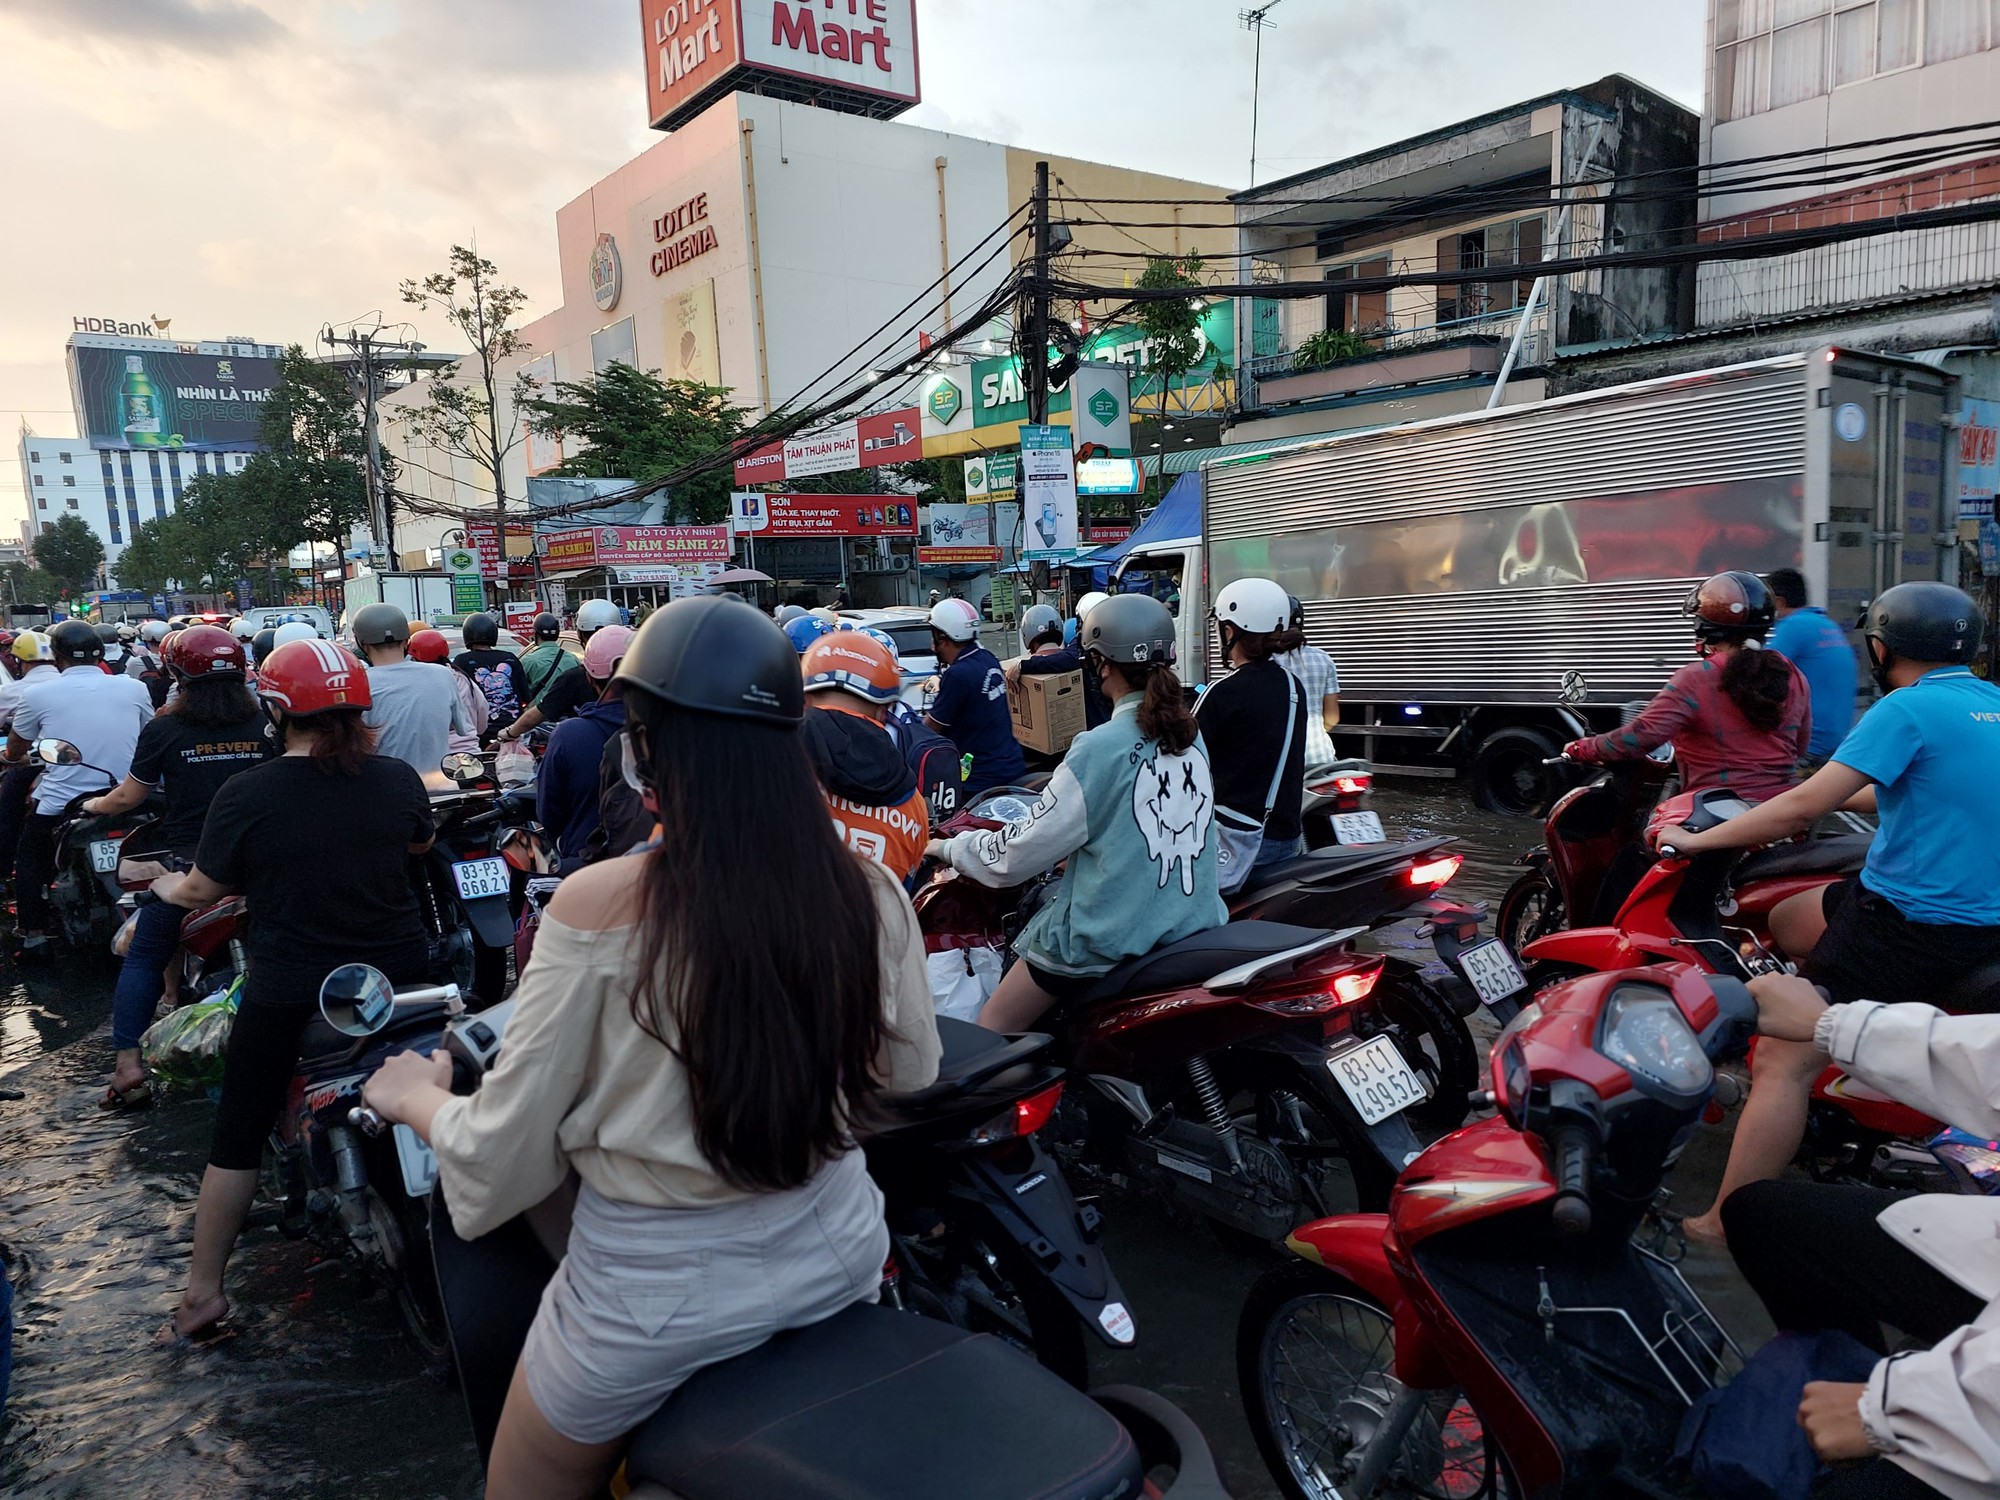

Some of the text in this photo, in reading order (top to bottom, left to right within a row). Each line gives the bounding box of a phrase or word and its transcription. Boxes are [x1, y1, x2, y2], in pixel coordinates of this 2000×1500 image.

[772, 1, 891, 71] Mart
[659, 8, 722, 92] Mart
[653, 192, 708, 243] LOTTE
[650, 225, 718, 277] CINEMA
[73, 316, 154, 336] HDBank
[176, 385, 218, 400] NHÌN
[220, 386, 240, 401] LÀ
[935, 391, 953, 405] SP
[1095, 400, 1114, 411] SP
[786, 437, 856, 459] TÂM THUẬN PHÁT
[746, 453, 783, 468] ARISTON
[770, 497, 791, 507] SƠN
[772, 508, 787, 516] RỬA
[773, 518, 787, 527] HÚT
[635, 527, 716, 537] BÒ TƠ TÂY NINH
[585, 541, 593, 552] 27
[626, 537, 727, 552] NĂM SÁNH 27
[195, 741, 260, 755] PR-EVENT
[187, 753, 236, 763] POLYTECHNIC
[931, 781, 956, 810] ila
[461, 861, 500, 880] 83-P3
[461, 875, 509, 896] 968.21
[1475, 964, 1522, 1000] 545.75
[1329, 1037, 1353, 1050] HONDA
[1340, 1044, 1394, 1087] 83-C1
[1356, 1069, 1420, 1118] 499.52
[1015, 1174, 1047, 1195] HONDA
